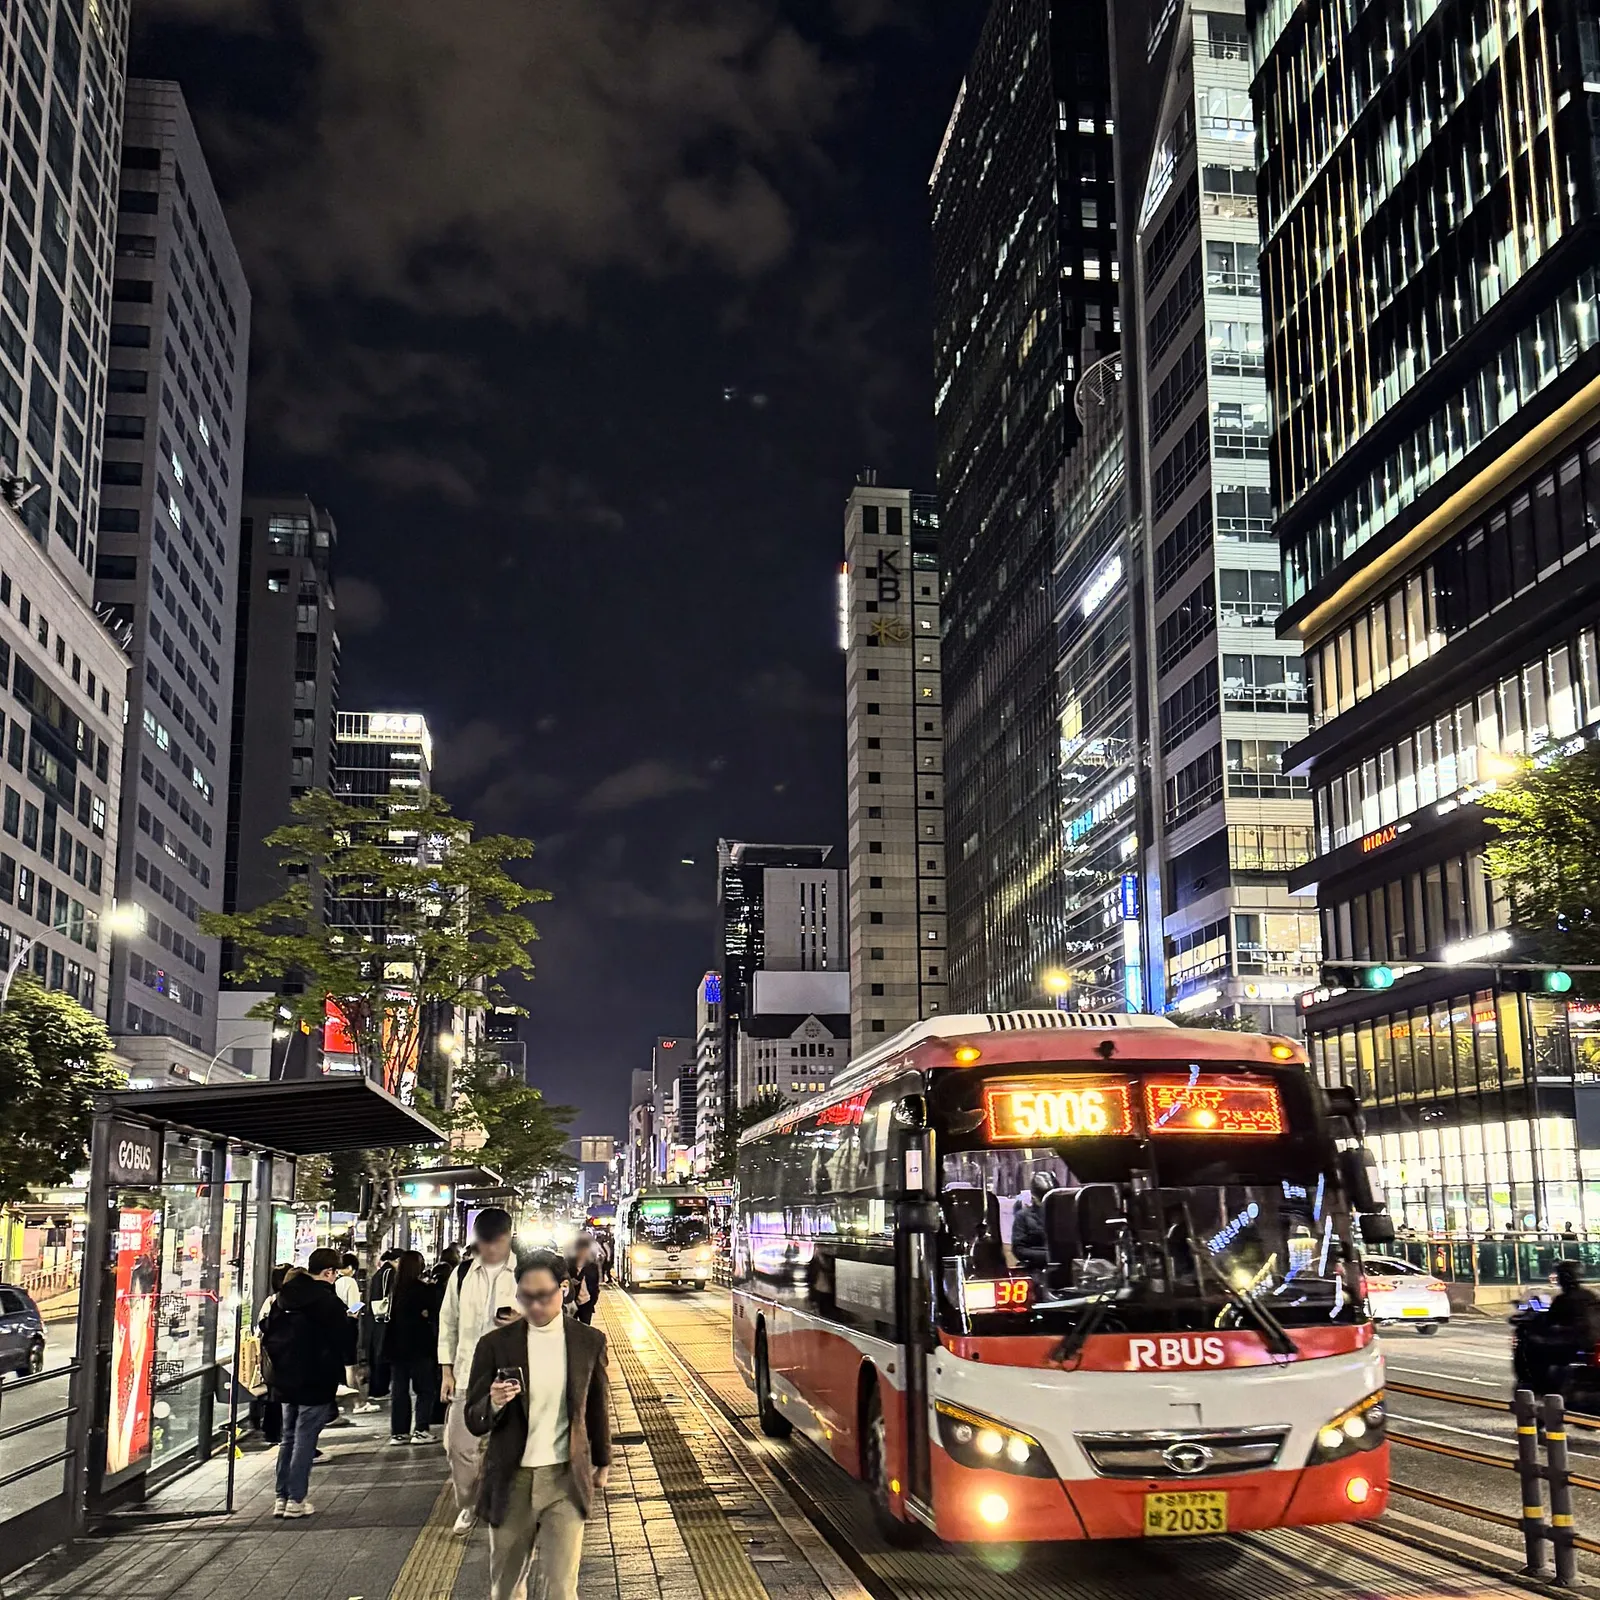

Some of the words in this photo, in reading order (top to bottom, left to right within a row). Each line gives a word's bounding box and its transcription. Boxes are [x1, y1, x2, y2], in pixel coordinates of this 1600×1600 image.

[878, 549, 901, 602] KB
[1011, 1091, 1105, 1134] 5006
[996, 1281, 1028, 1304] 38
